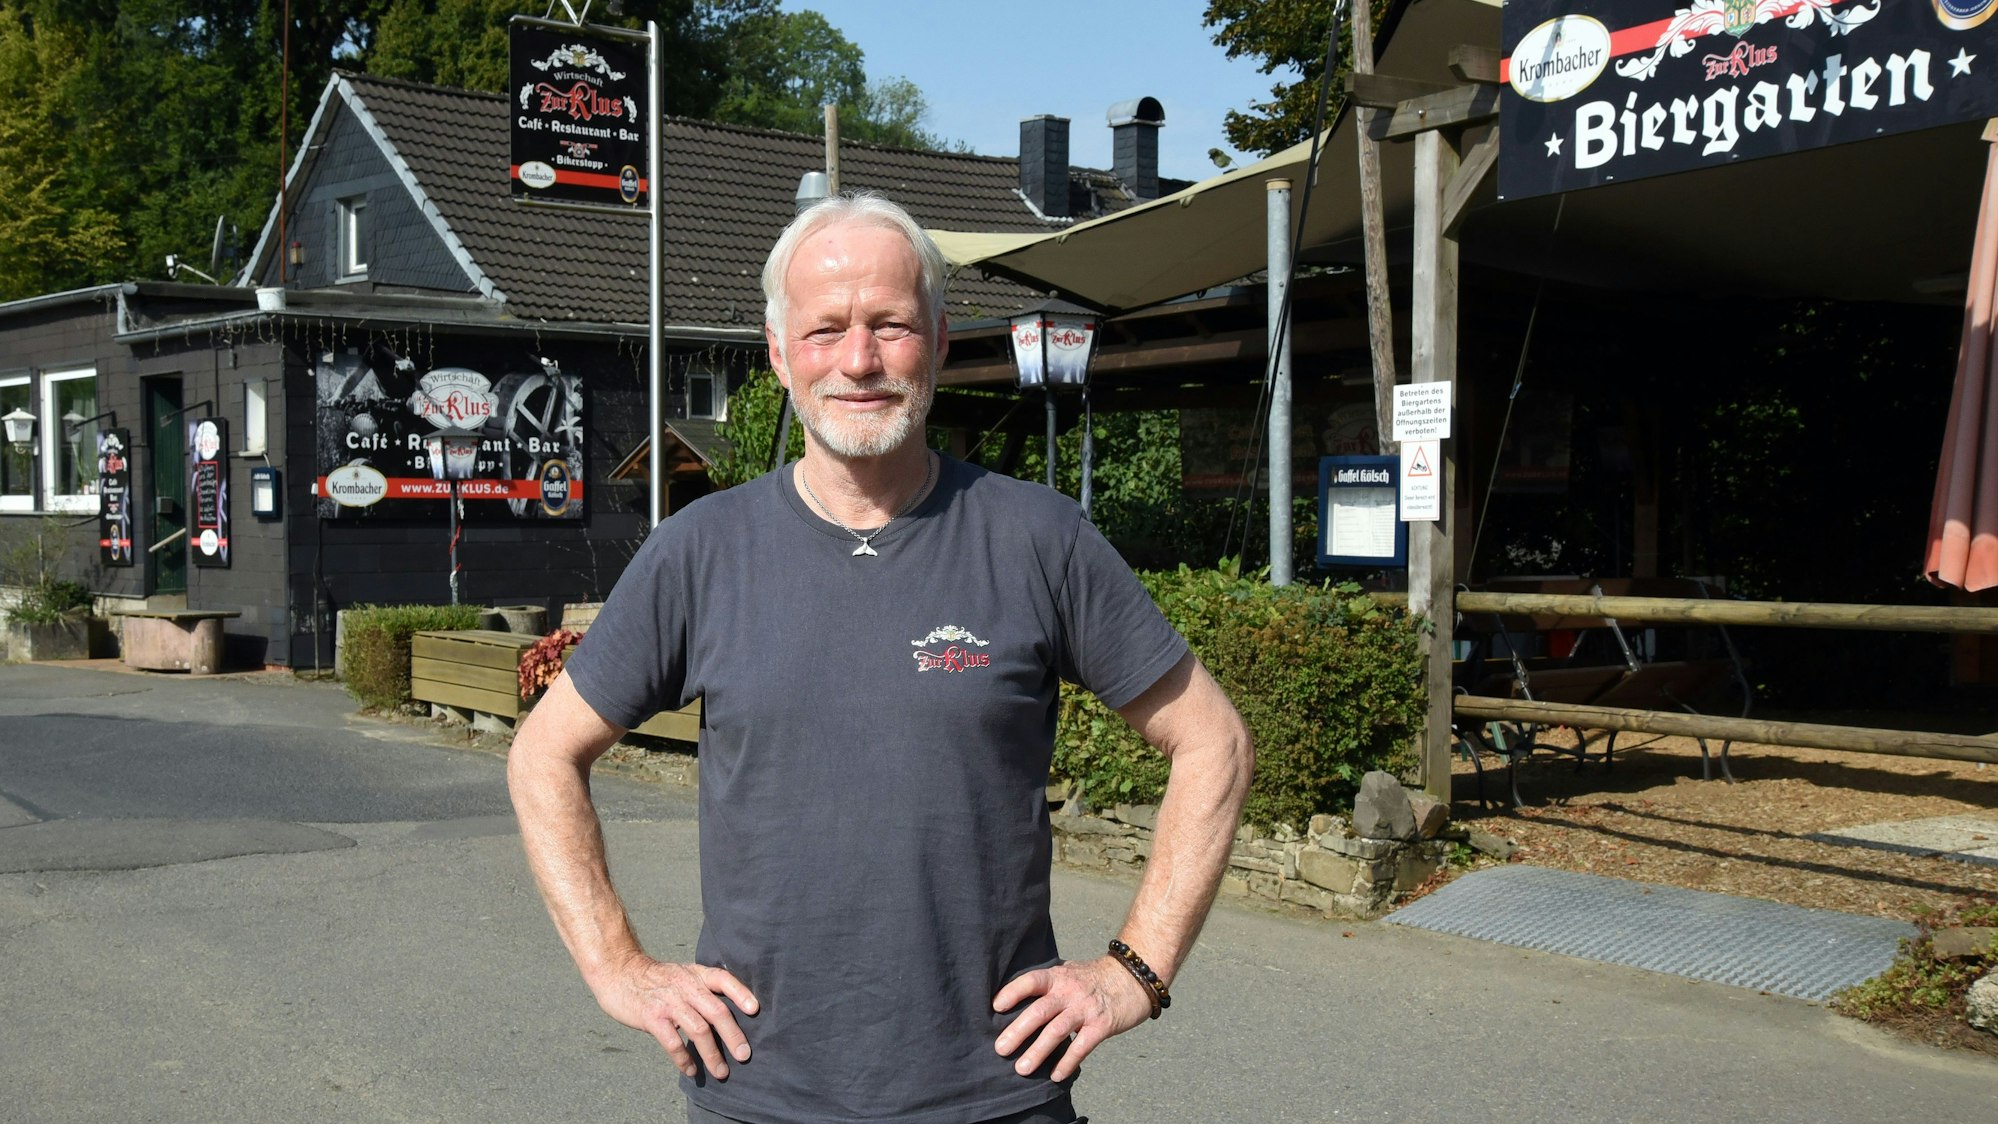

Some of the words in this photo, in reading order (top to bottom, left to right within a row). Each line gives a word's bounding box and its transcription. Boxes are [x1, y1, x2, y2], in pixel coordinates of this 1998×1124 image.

[1520, 46, 1602, 83] Krombacher
[1702, 55, 1729, 81] Zur
[1728, 41, 1778, 78] Klus
[553, 71, 603, 88] Wirtschaft
[537, 87, 568, 113] Zur
[567, 81, 623, 121] Klus
[1575, 47, 1934, 169] Biergarten
[518, 116, 543, 131] Café
[551, 120, 612, 138] Restaurant
[618, 128, 639, 142] Bar
[556, 155, 604, 170] Bikerstopp
[522, 170, 553, 182] Krombacher
[430, 373, 481, 386] Wirtschaft
[1400, 389, 1430, 398] Betreten
[1431, 387, 1444, 395] des
[446, 390, 491, 421] Klus
[1401, 398, 1442, 407] Biergartens
[1398, 408, 1432, 416] außerhalb
[1405, 427, 1437, 435] verboten!
[346, 431, 388, 451] Café
[528, 436, 560, 453] Bar
[1338, 469, 1359, 483] Gaffel
[1360, 469, 1390, 484] Kölsch
[332, 481, 383, 495] Krombacher
[401, 483, 509, 494] www.ZUKLUS.de
[543, 480, 567, 492] Gaffel
[915, 652, 941, 673] Zur
[943, 644, 991, 673] Klus
